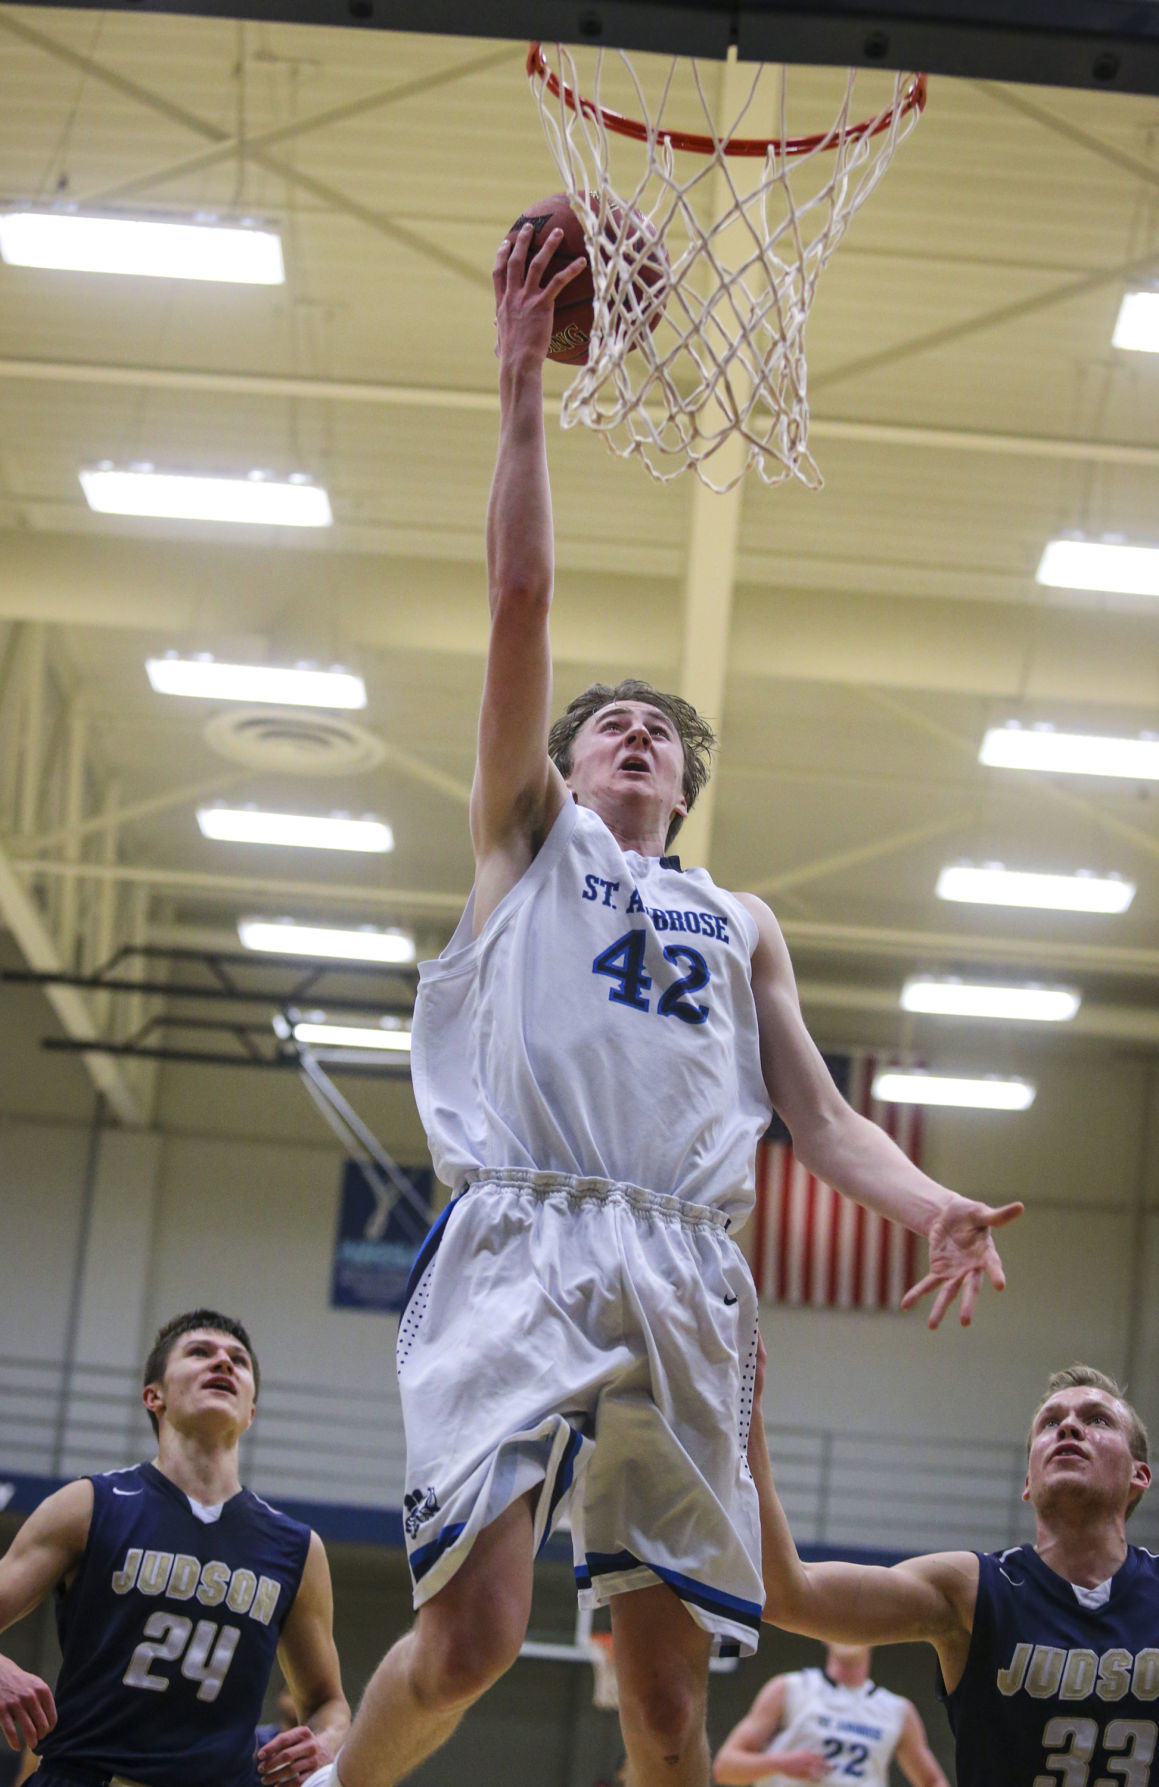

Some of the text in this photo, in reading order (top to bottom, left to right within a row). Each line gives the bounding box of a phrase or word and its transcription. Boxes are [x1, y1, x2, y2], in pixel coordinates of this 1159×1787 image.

[581, 873, 730, 944] ST. ABROSE
[591, 928, 711, 1024] 42
[111, 1548, 281, 1626] JUDSON
[122, 1611, 241, 1703] 24
[1032, 1716, 1159, 1787] 33
